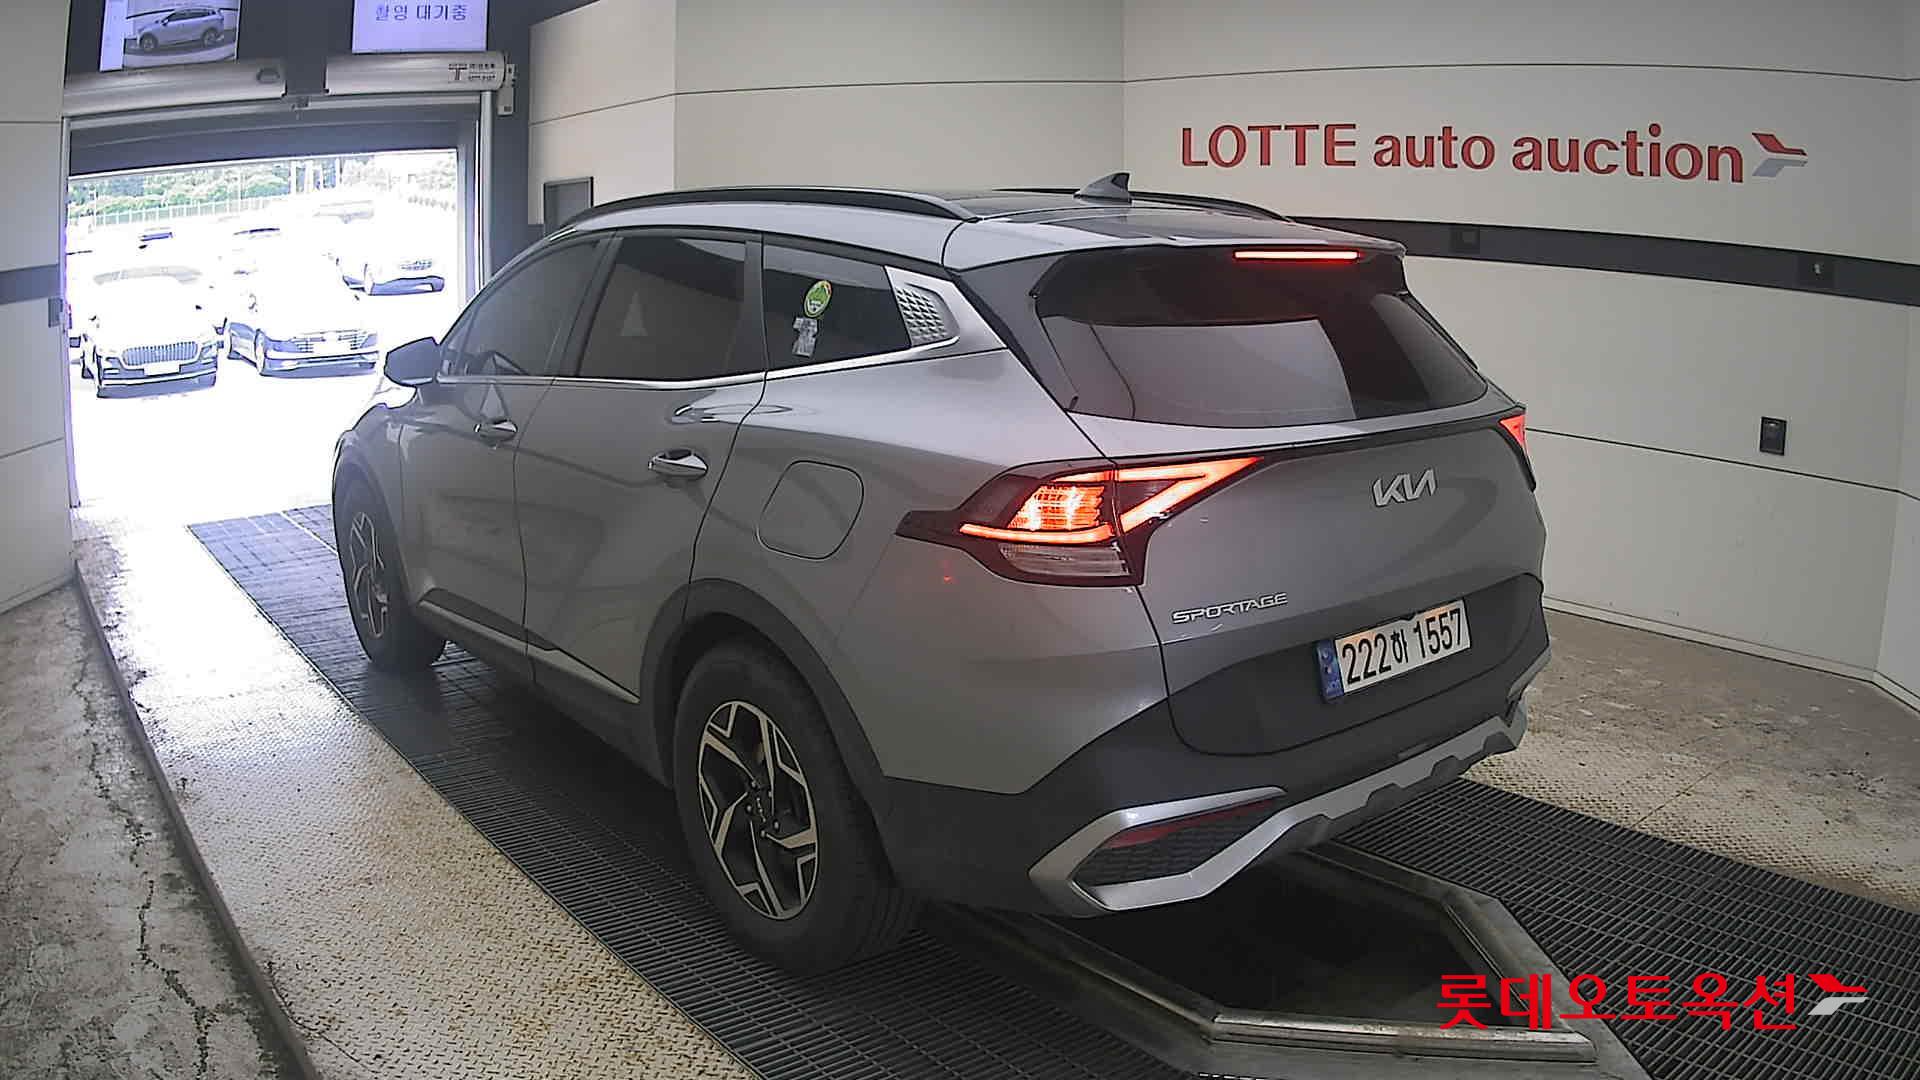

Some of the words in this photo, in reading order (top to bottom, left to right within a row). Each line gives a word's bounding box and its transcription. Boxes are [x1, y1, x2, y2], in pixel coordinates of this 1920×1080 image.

[416, 4, 467, 21] 대기중
[1181, 123, 1357, 168] LOTTE
[1373, 126, 1495, 169] auto
[1512, 123, 1744, 184] auction
[1171, 592, 1289, 625] SPORTAGE
[1342, 628, 1409, 685] 222하
[1413, 607, 1462, 659] 1557
